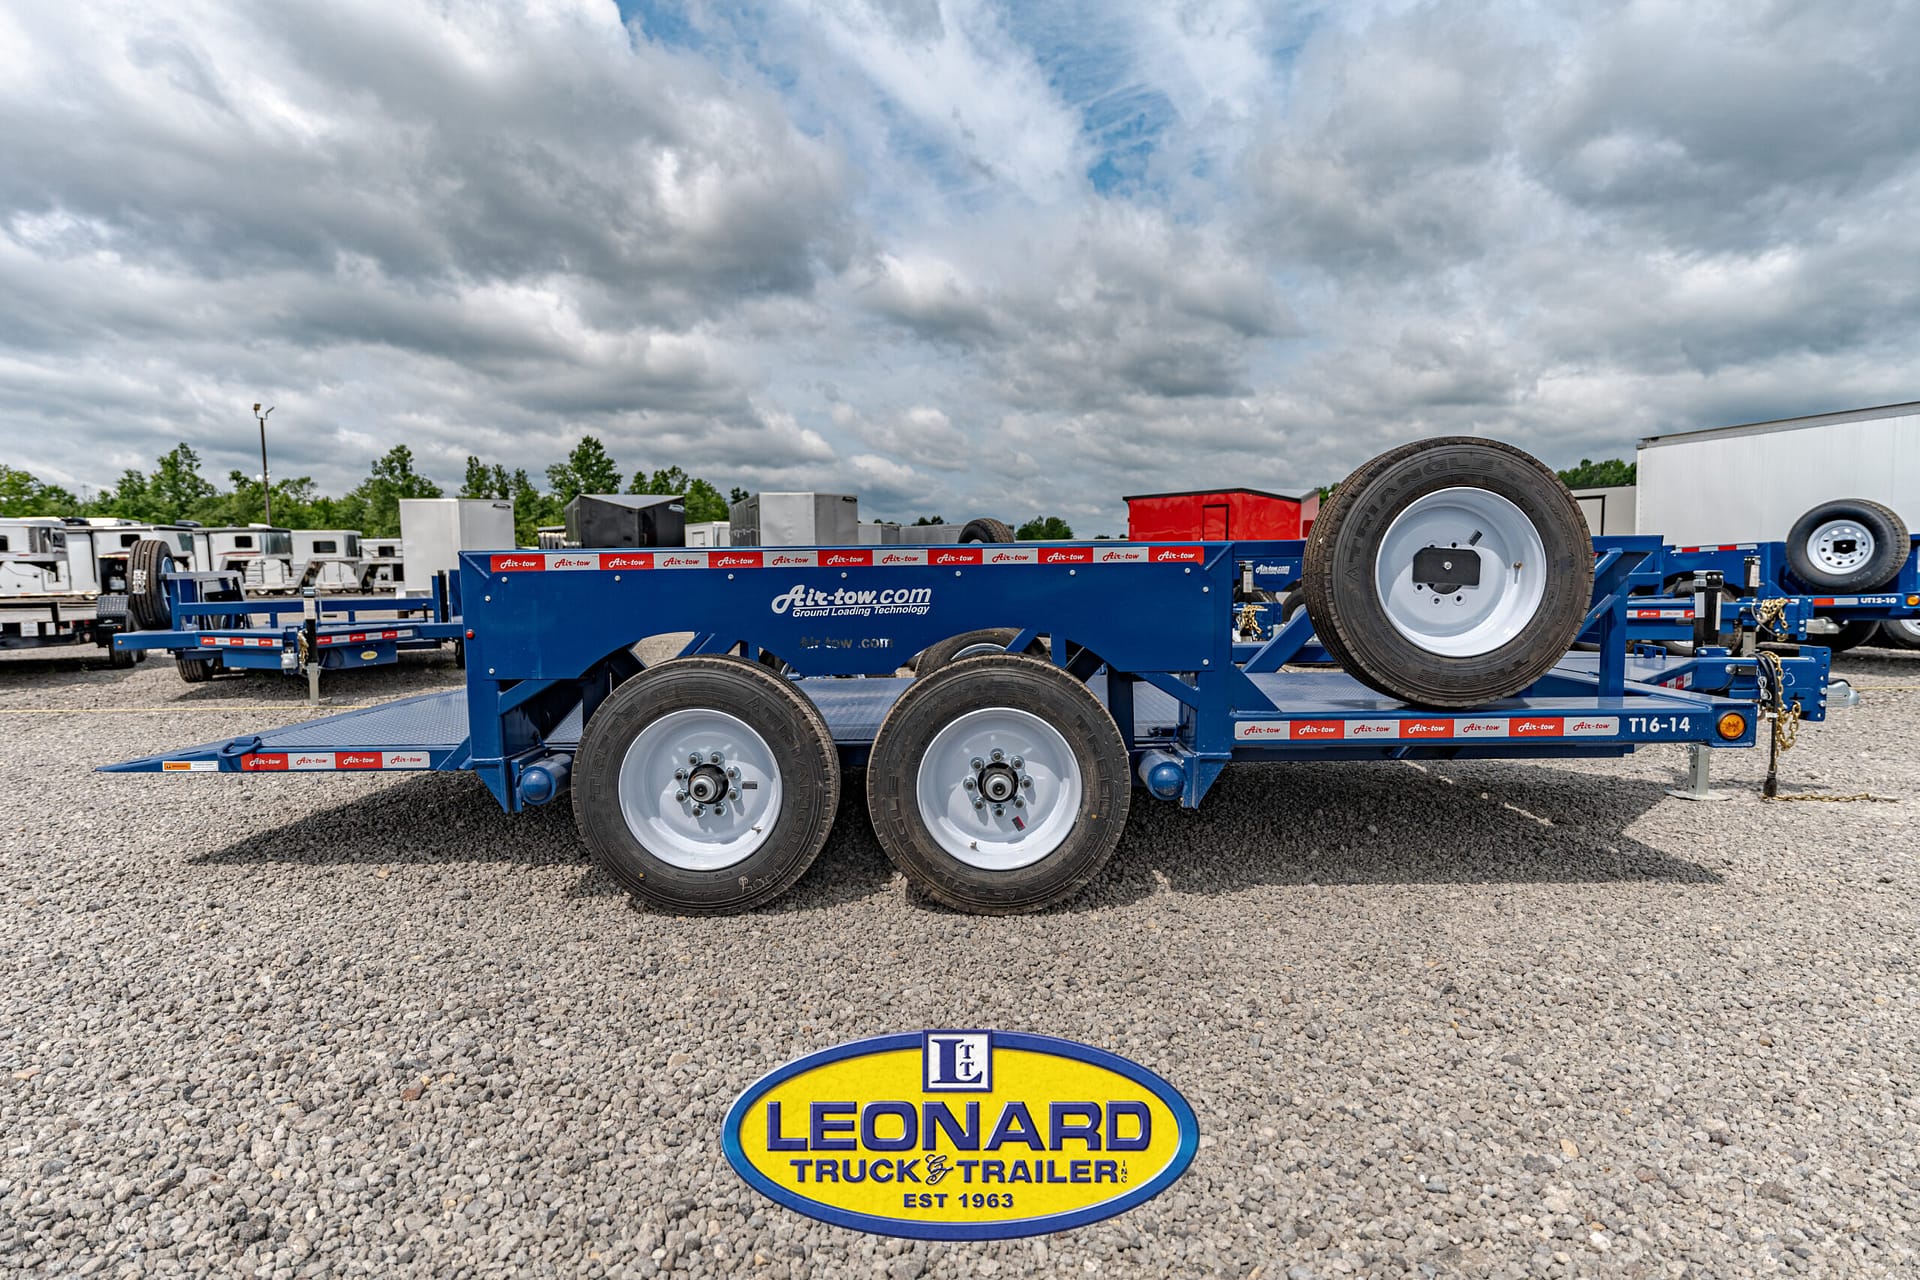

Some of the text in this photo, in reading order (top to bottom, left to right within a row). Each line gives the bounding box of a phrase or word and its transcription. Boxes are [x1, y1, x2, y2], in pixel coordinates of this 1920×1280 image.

[500, 550, 1194, 569] Air-tow Air-tow Air-tow Air-tow Air-tow Air-tow Air-tow Air-tow Air-tow Air-tow Air-tow Air-tow Air-tow
[771, 584, 932, 614] Air-tow.com
[792, 605, 930, 618] Ground Loading Technology
[1244, 717, 1690, 735] Air-tow Air-tow Air-tow Air-tow Air-tow Air-tow Air-tow T16-14
[249, 755, 422, 767] Air-tow Air-tow Air-tow Air-tow
